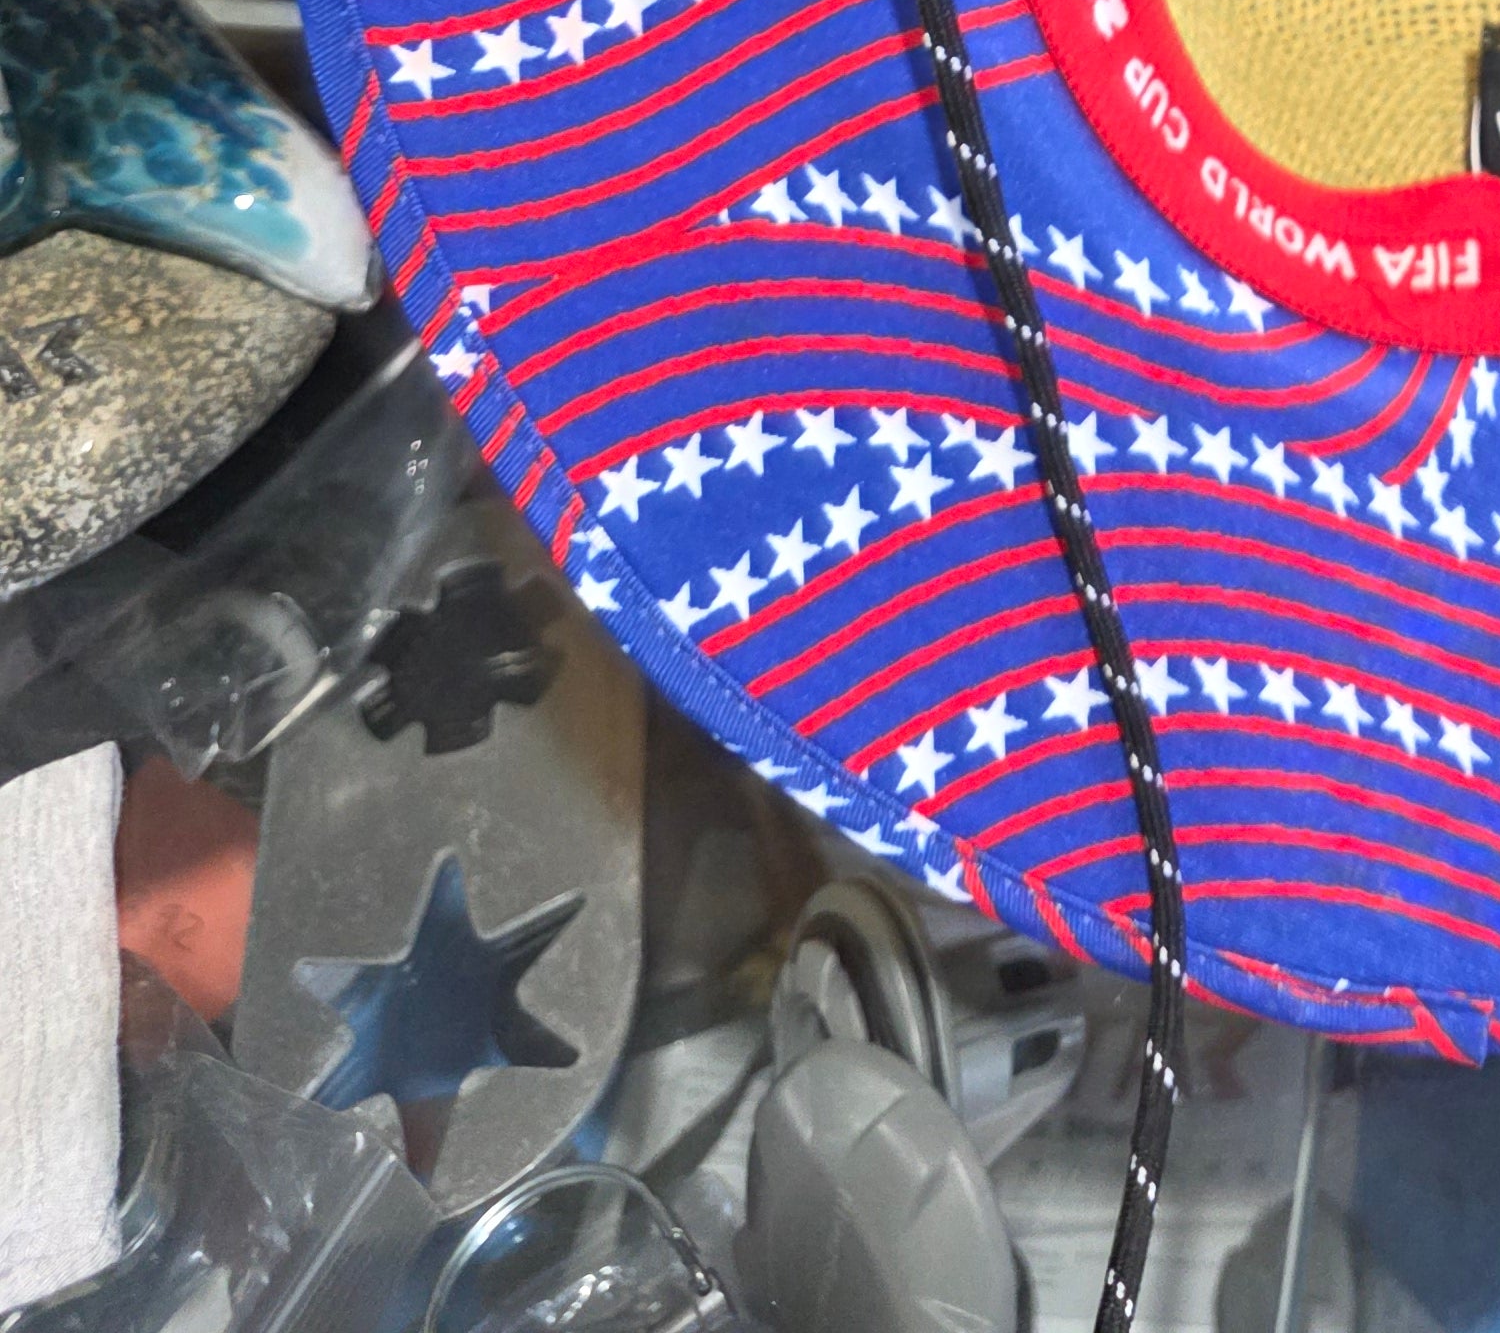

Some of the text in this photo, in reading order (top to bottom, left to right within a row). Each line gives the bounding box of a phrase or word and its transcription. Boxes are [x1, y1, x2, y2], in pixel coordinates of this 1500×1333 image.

[1123, 56, 1190, 153] CUP
[1200, 155, 1356, 280] WORLD
[1372, 238, 1481, 292] FIFA
